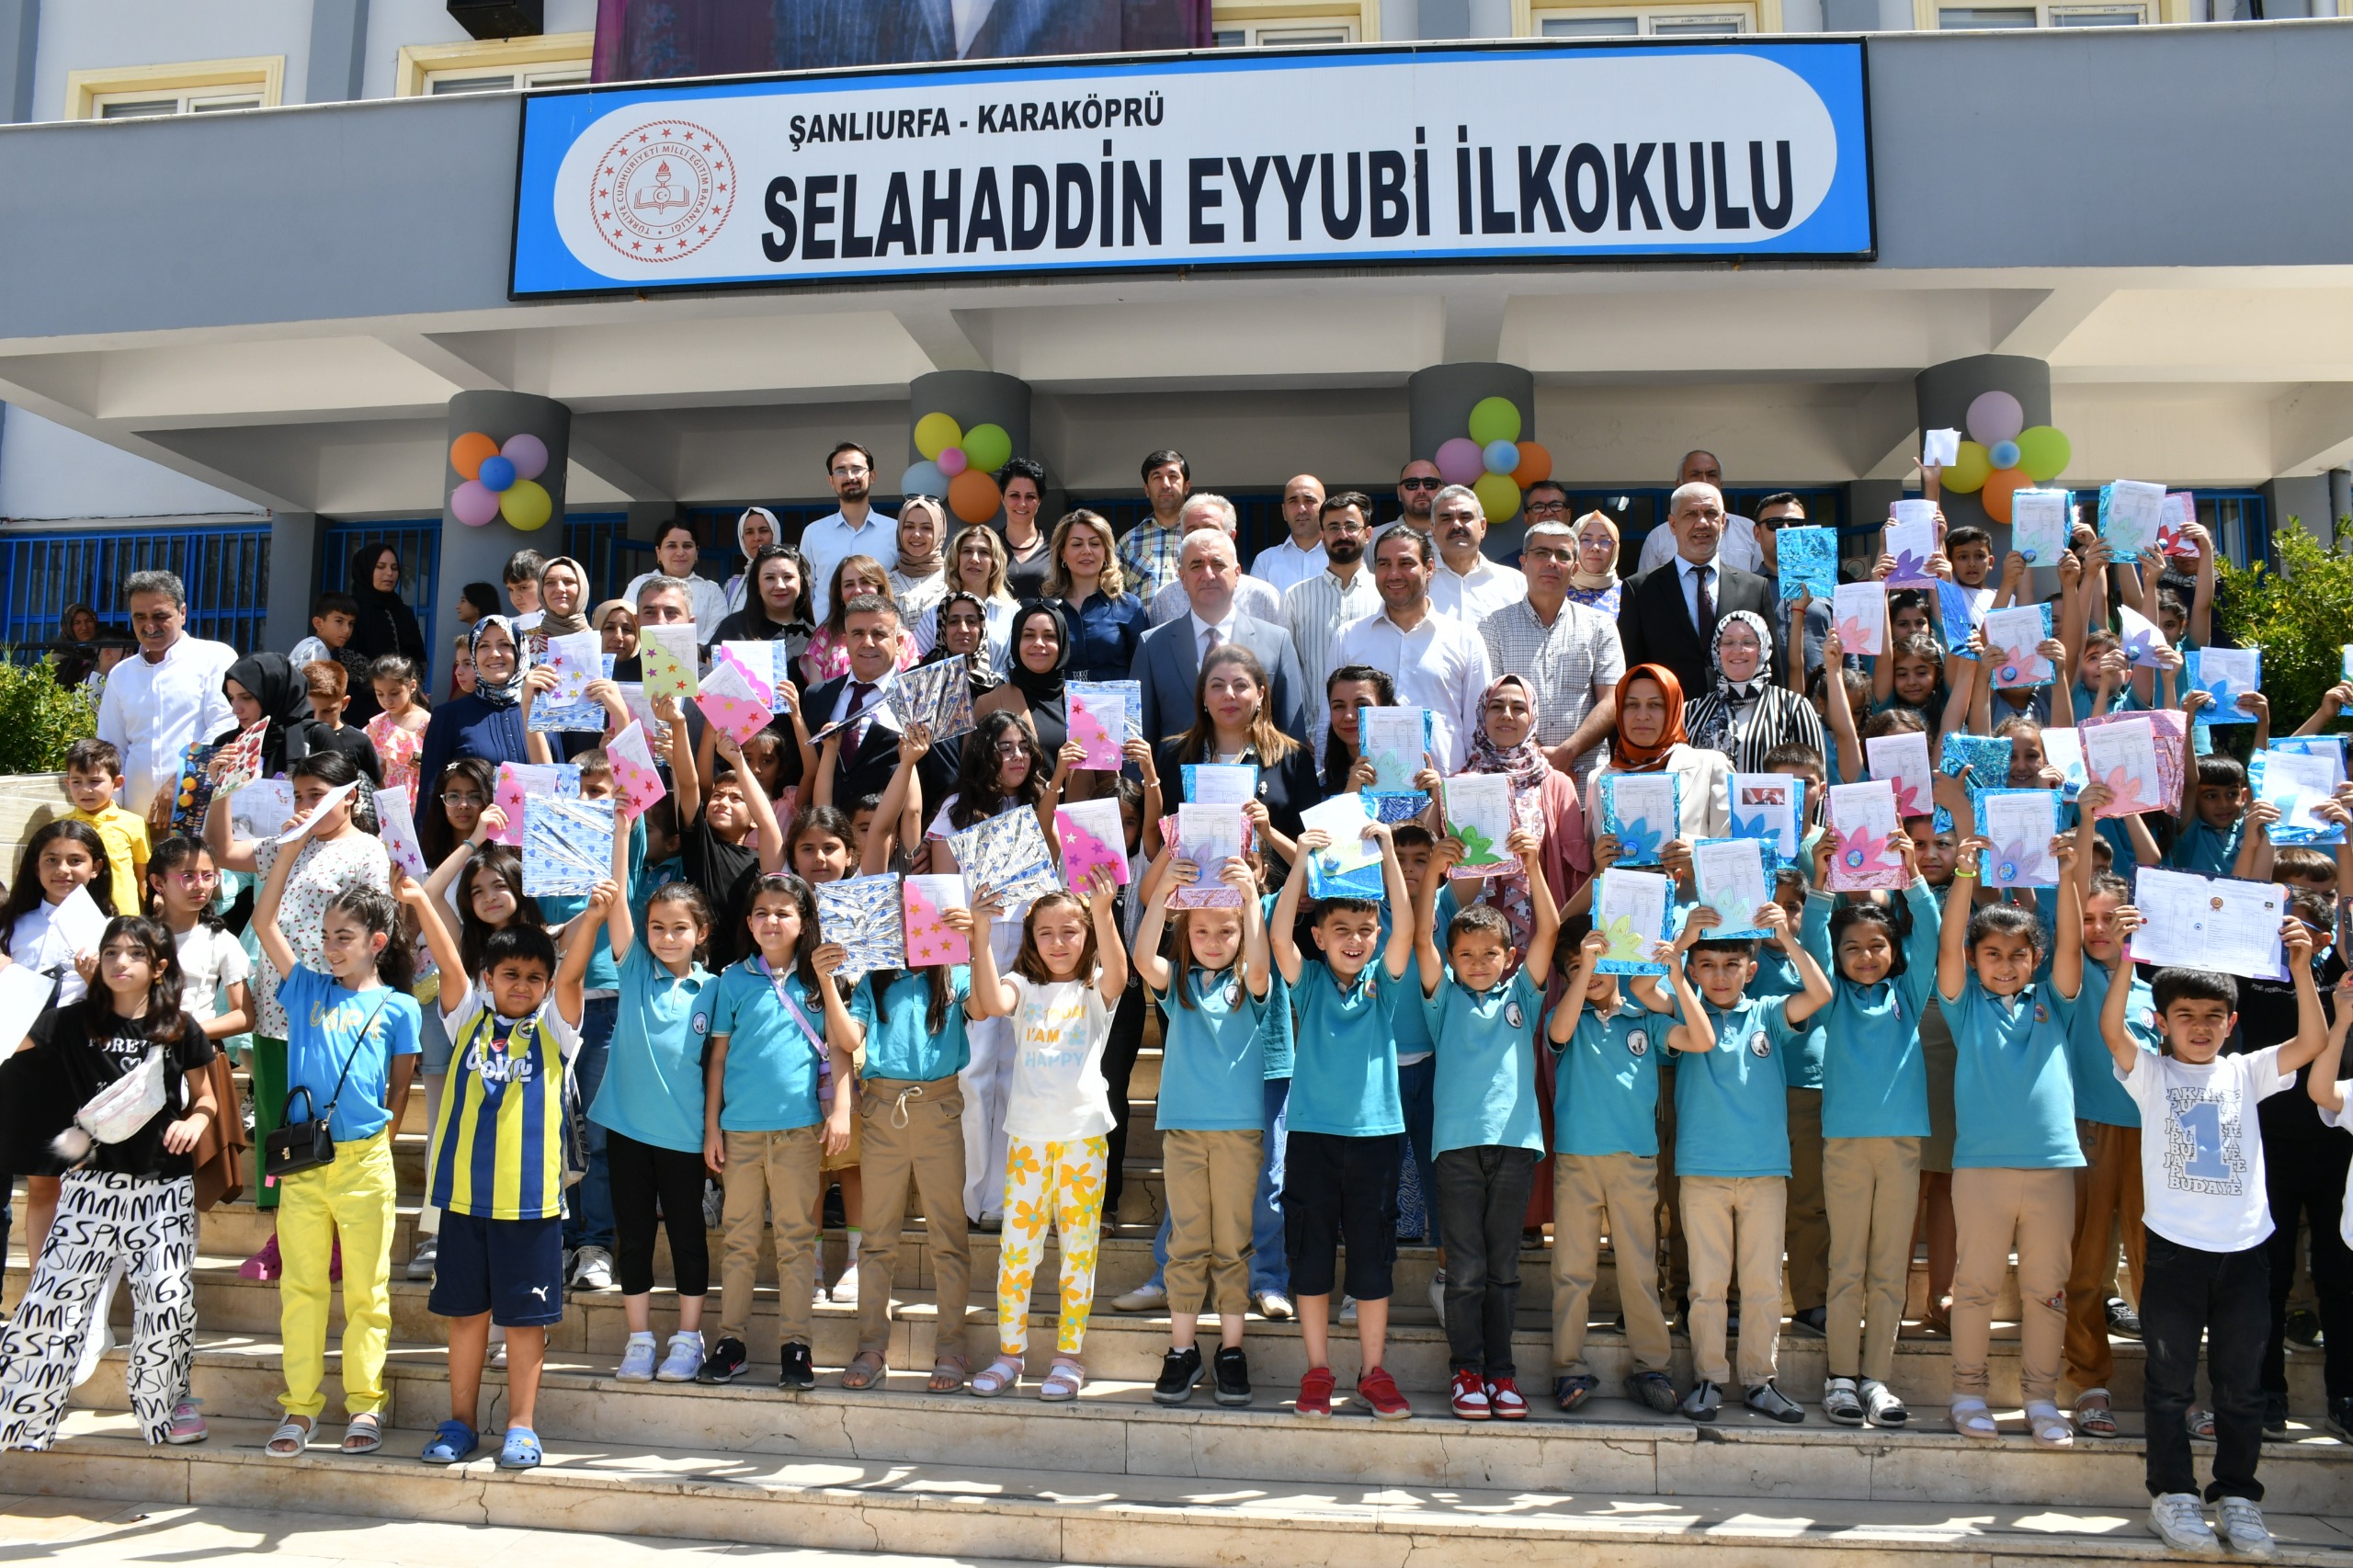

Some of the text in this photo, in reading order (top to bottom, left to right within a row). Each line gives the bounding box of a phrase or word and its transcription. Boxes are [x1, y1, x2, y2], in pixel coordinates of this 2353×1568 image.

[790, 108, 950, 152] ŞANLIURFA
[978, 91, 1165, 133] KARAKÖPRÜ
[617, 145, 709, 235] TÜRKİYE CUMHURİYETİ MİLLİ EĞİTİM BAKANLIĞI
[761, 124, 1793, 262] SELAHADDİN EYYUBİ İLKOKULU
[1025, 1051, 1084, 1067] HAPPY
